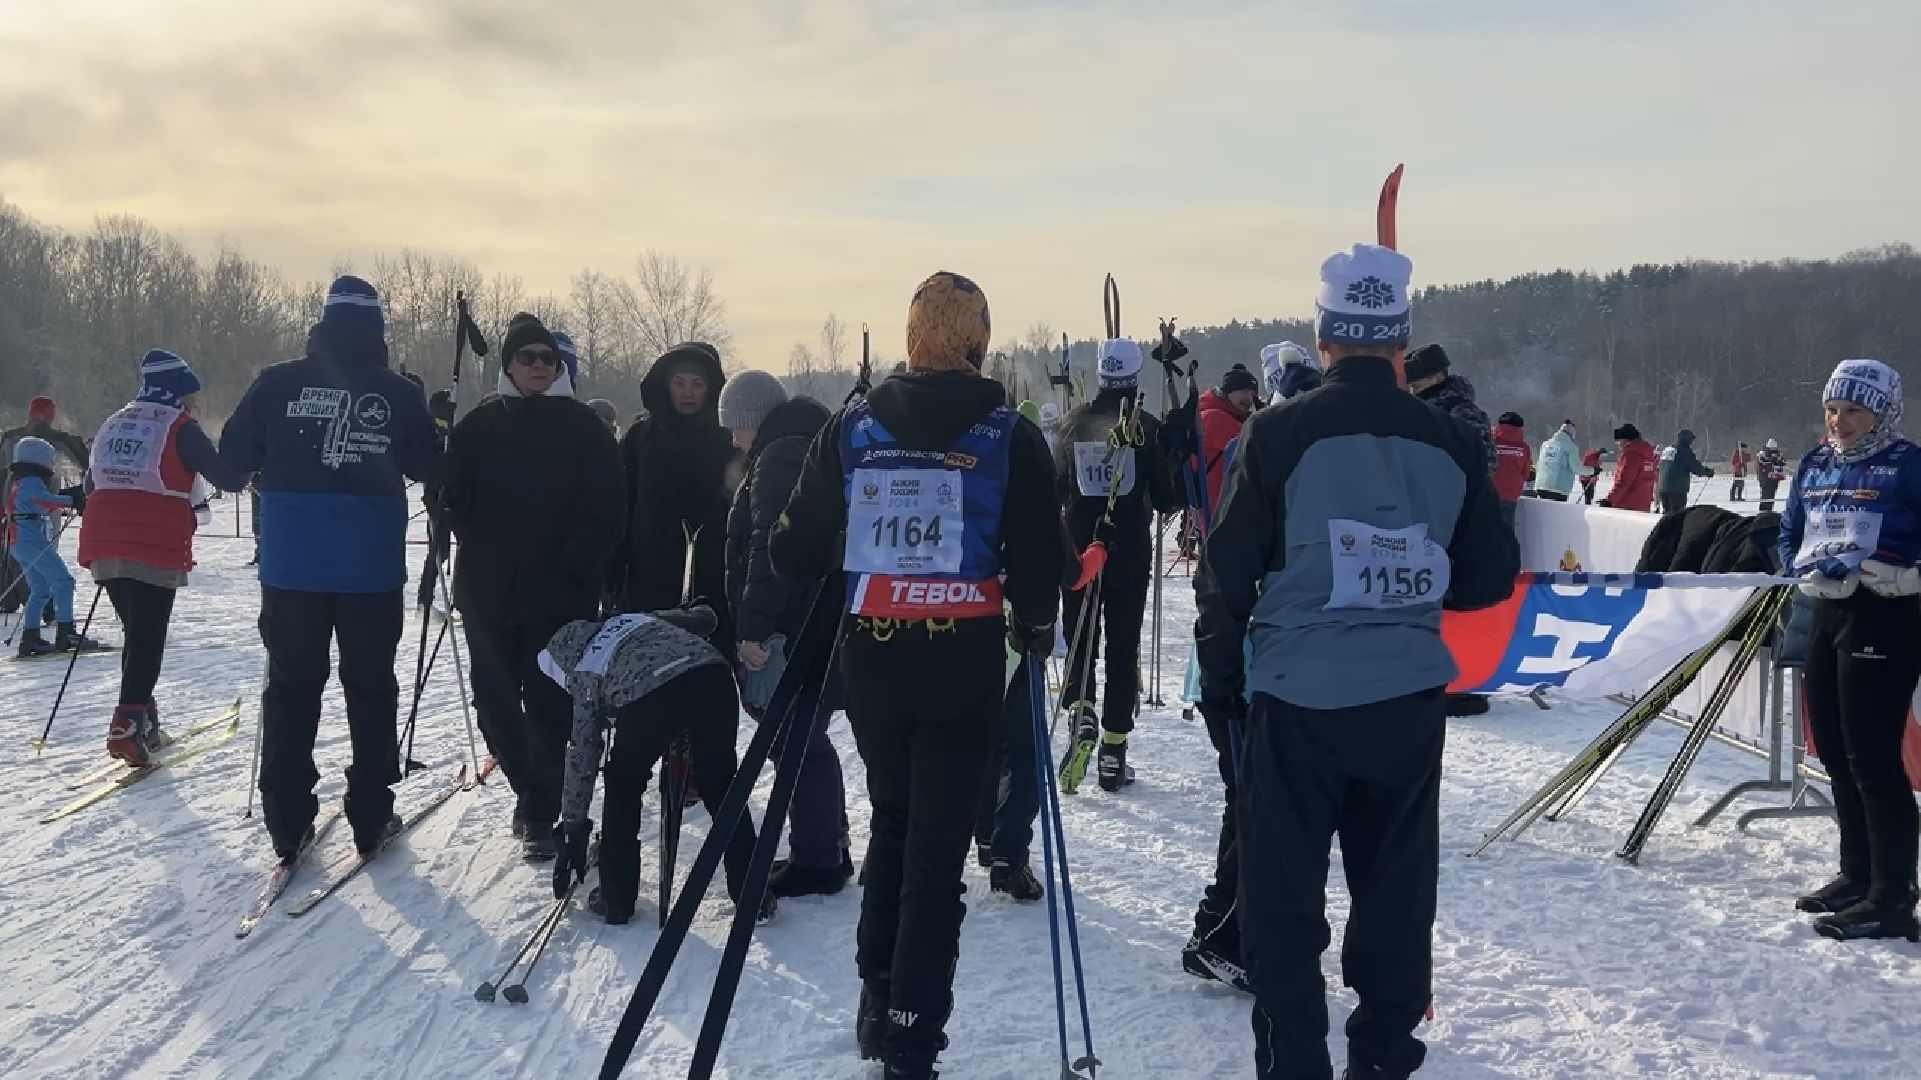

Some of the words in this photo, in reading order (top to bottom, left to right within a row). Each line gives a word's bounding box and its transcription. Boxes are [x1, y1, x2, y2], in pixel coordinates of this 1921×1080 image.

[1333, 320, 1365, 339] 20
[302, 389, 341, 401] ВРЕМЯ
[289, 402, 337, 415] ЛУЧШИХ
[106, 438, 143, 455] 1057
[1085, 464, 1126, 482] 116
[871, 515, 943, 548] 1164
[1358, 565, 1433, 596] 1156
[890, 580, 986, 605] TEBOIL
